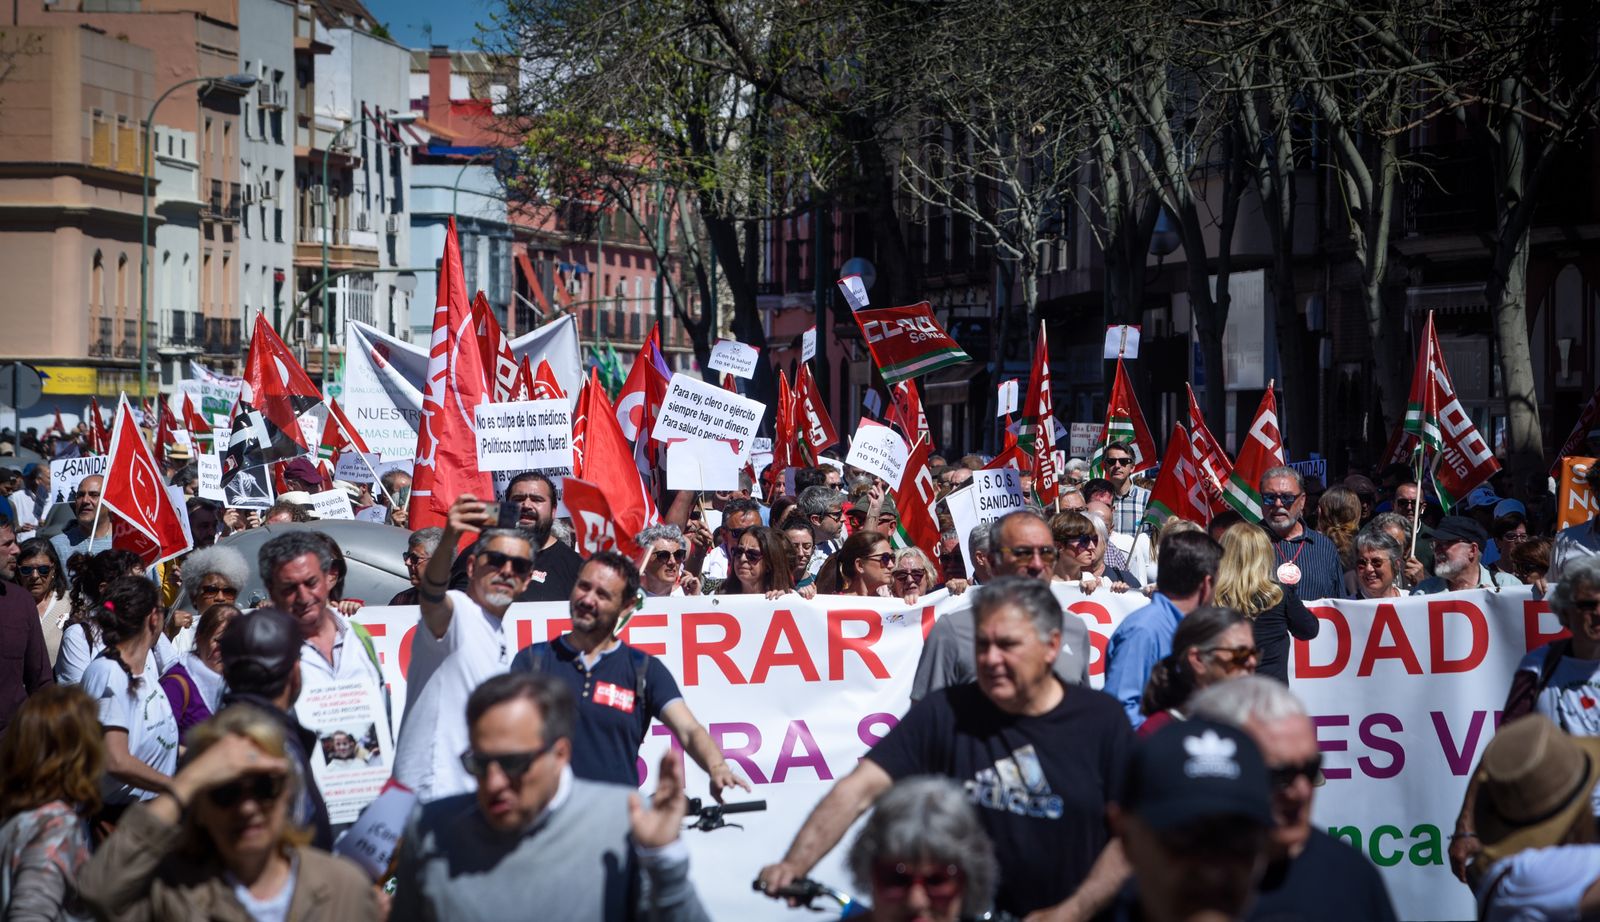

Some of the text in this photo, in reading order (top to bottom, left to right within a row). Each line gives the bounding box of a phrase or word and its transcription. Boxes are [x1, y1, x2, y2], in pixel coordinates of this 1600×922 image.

[672, 384, 689, 399] Para
[690, 392, 702, 404] rey,
[704, 396, 722, 410] clero
[729, 404, 756, 422] ejército
[476, 409, 568, 432] No es culpa de los médicos.
[662, 414, 678, 428] Para
[680, 422, 698, 436] salud
[668, 402, 750, 437] siempre hay un dinero.
[392, 428, 418, 440] MÉD
[480, 433, 568, 458] ¡Políticos corruptos, fuera!
[372, 446, 415, 456] SANIDA
[860, 441, 902, 470] ¡Con la salud
[70, 456, 108, 476] SANIDA
[856, 452, 898, 480] no se juega!
[984, 476, 993, 490] S.
[995, 474, 1005, 488] O.
[1006, 474, 1015, 488] S.
[980, 494, 1020, 510] SANIDAD
[1430, 710, 1503, 776] V
